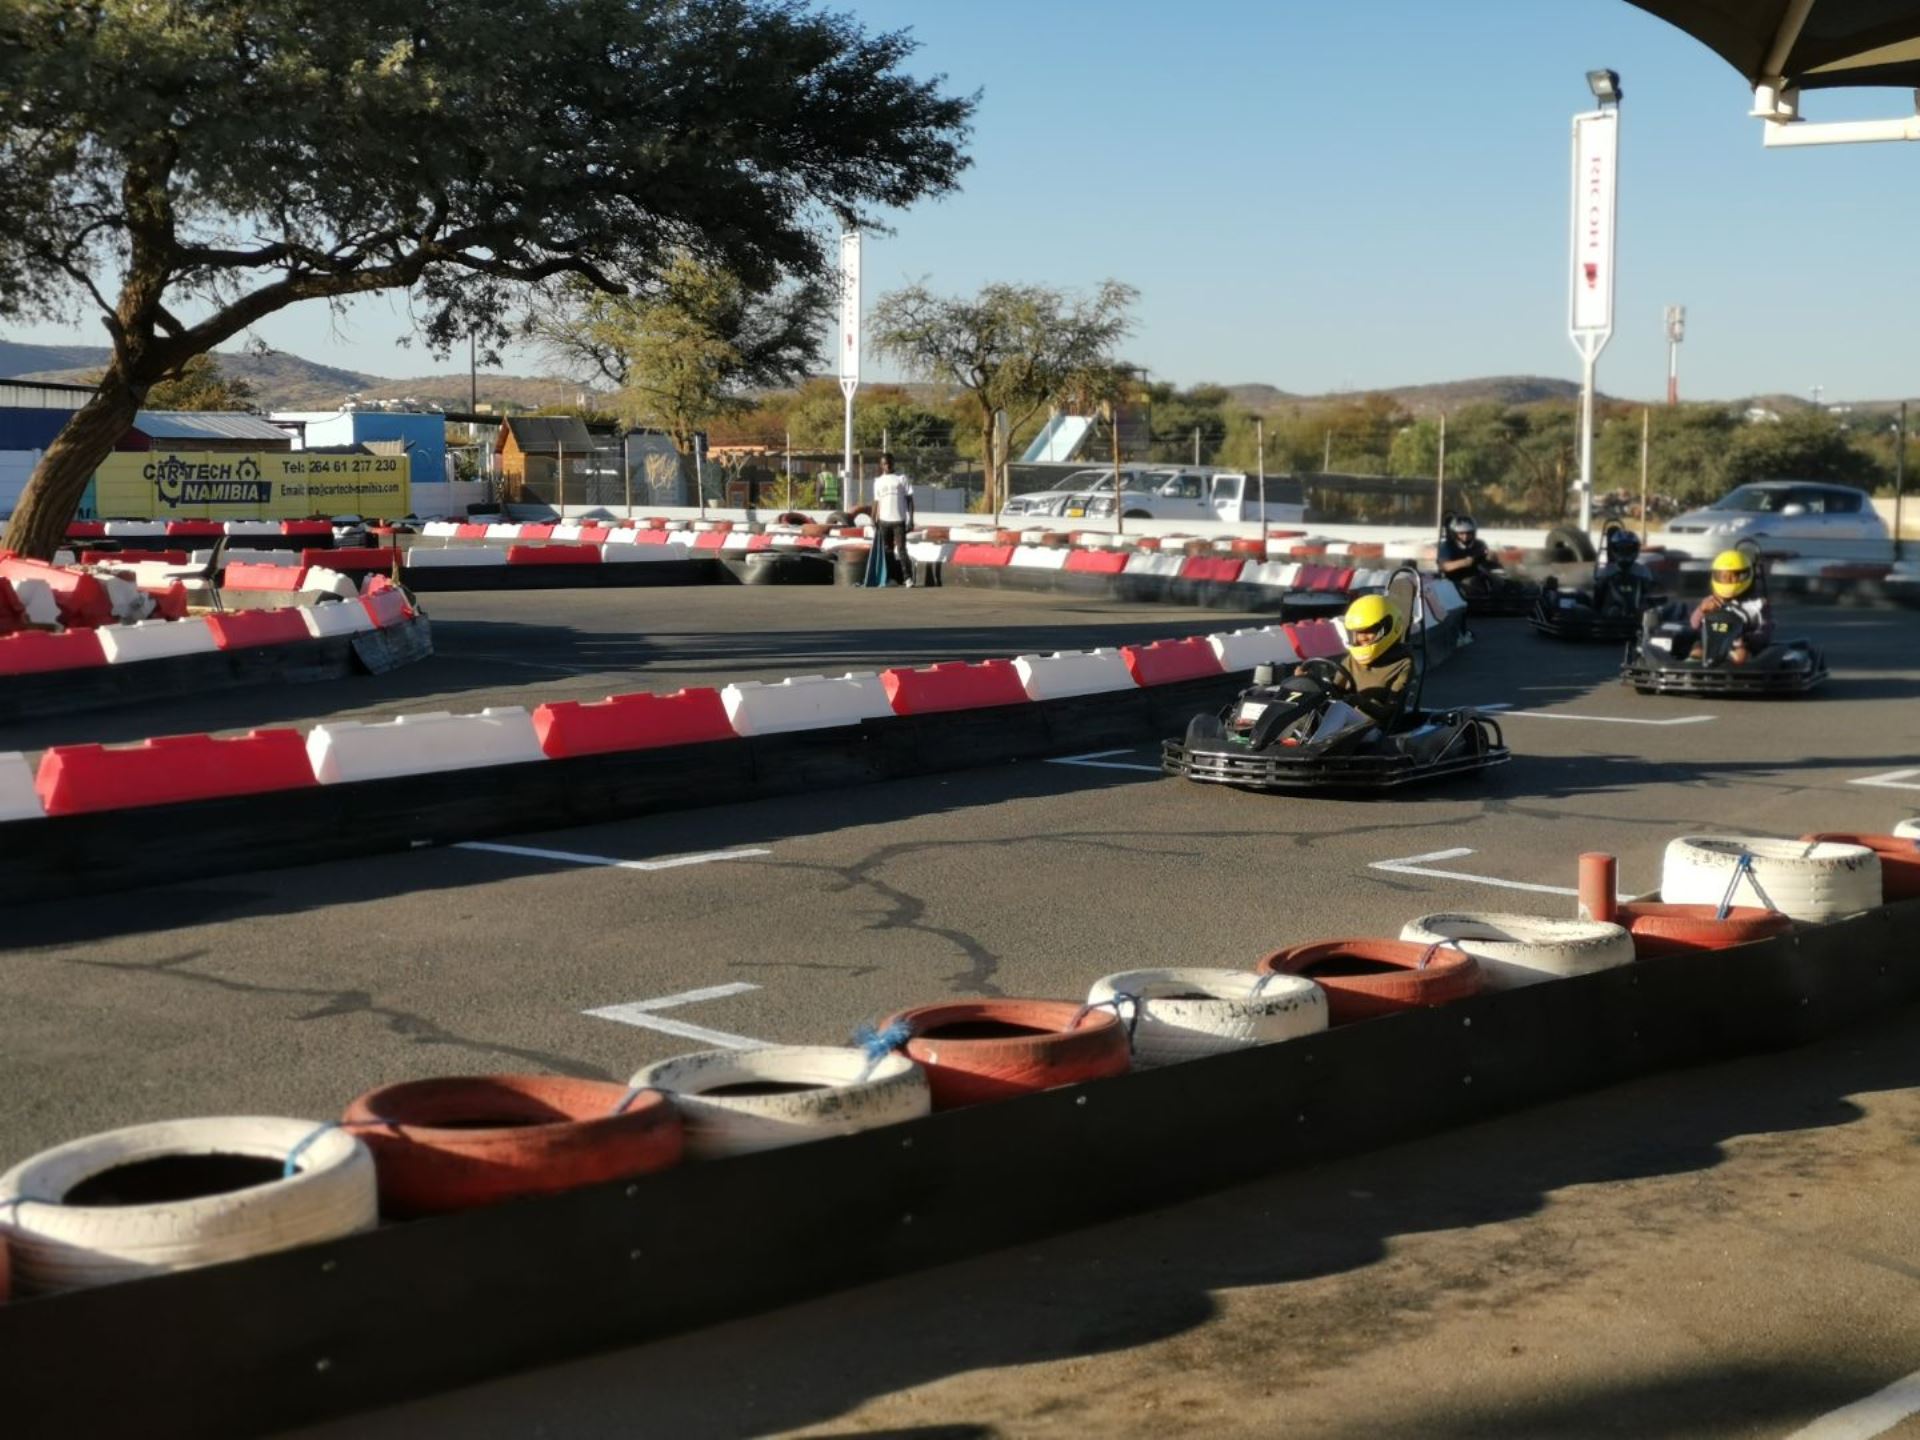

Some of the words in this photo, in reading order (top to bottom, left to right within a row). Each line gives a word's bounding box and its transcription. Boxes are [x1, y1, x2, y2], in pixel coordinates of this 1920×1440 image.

[282, 461, 304, 473] Tel:
[309, 460, 330, 473] 264
[333, 460, 347, 473] 61
[375, 459, 397, 472] 230
[184, 483, 259, 501] NAMIBIA
[281, 484, 305, 497] Email:
[1710, 622, 1728, 633] 12
